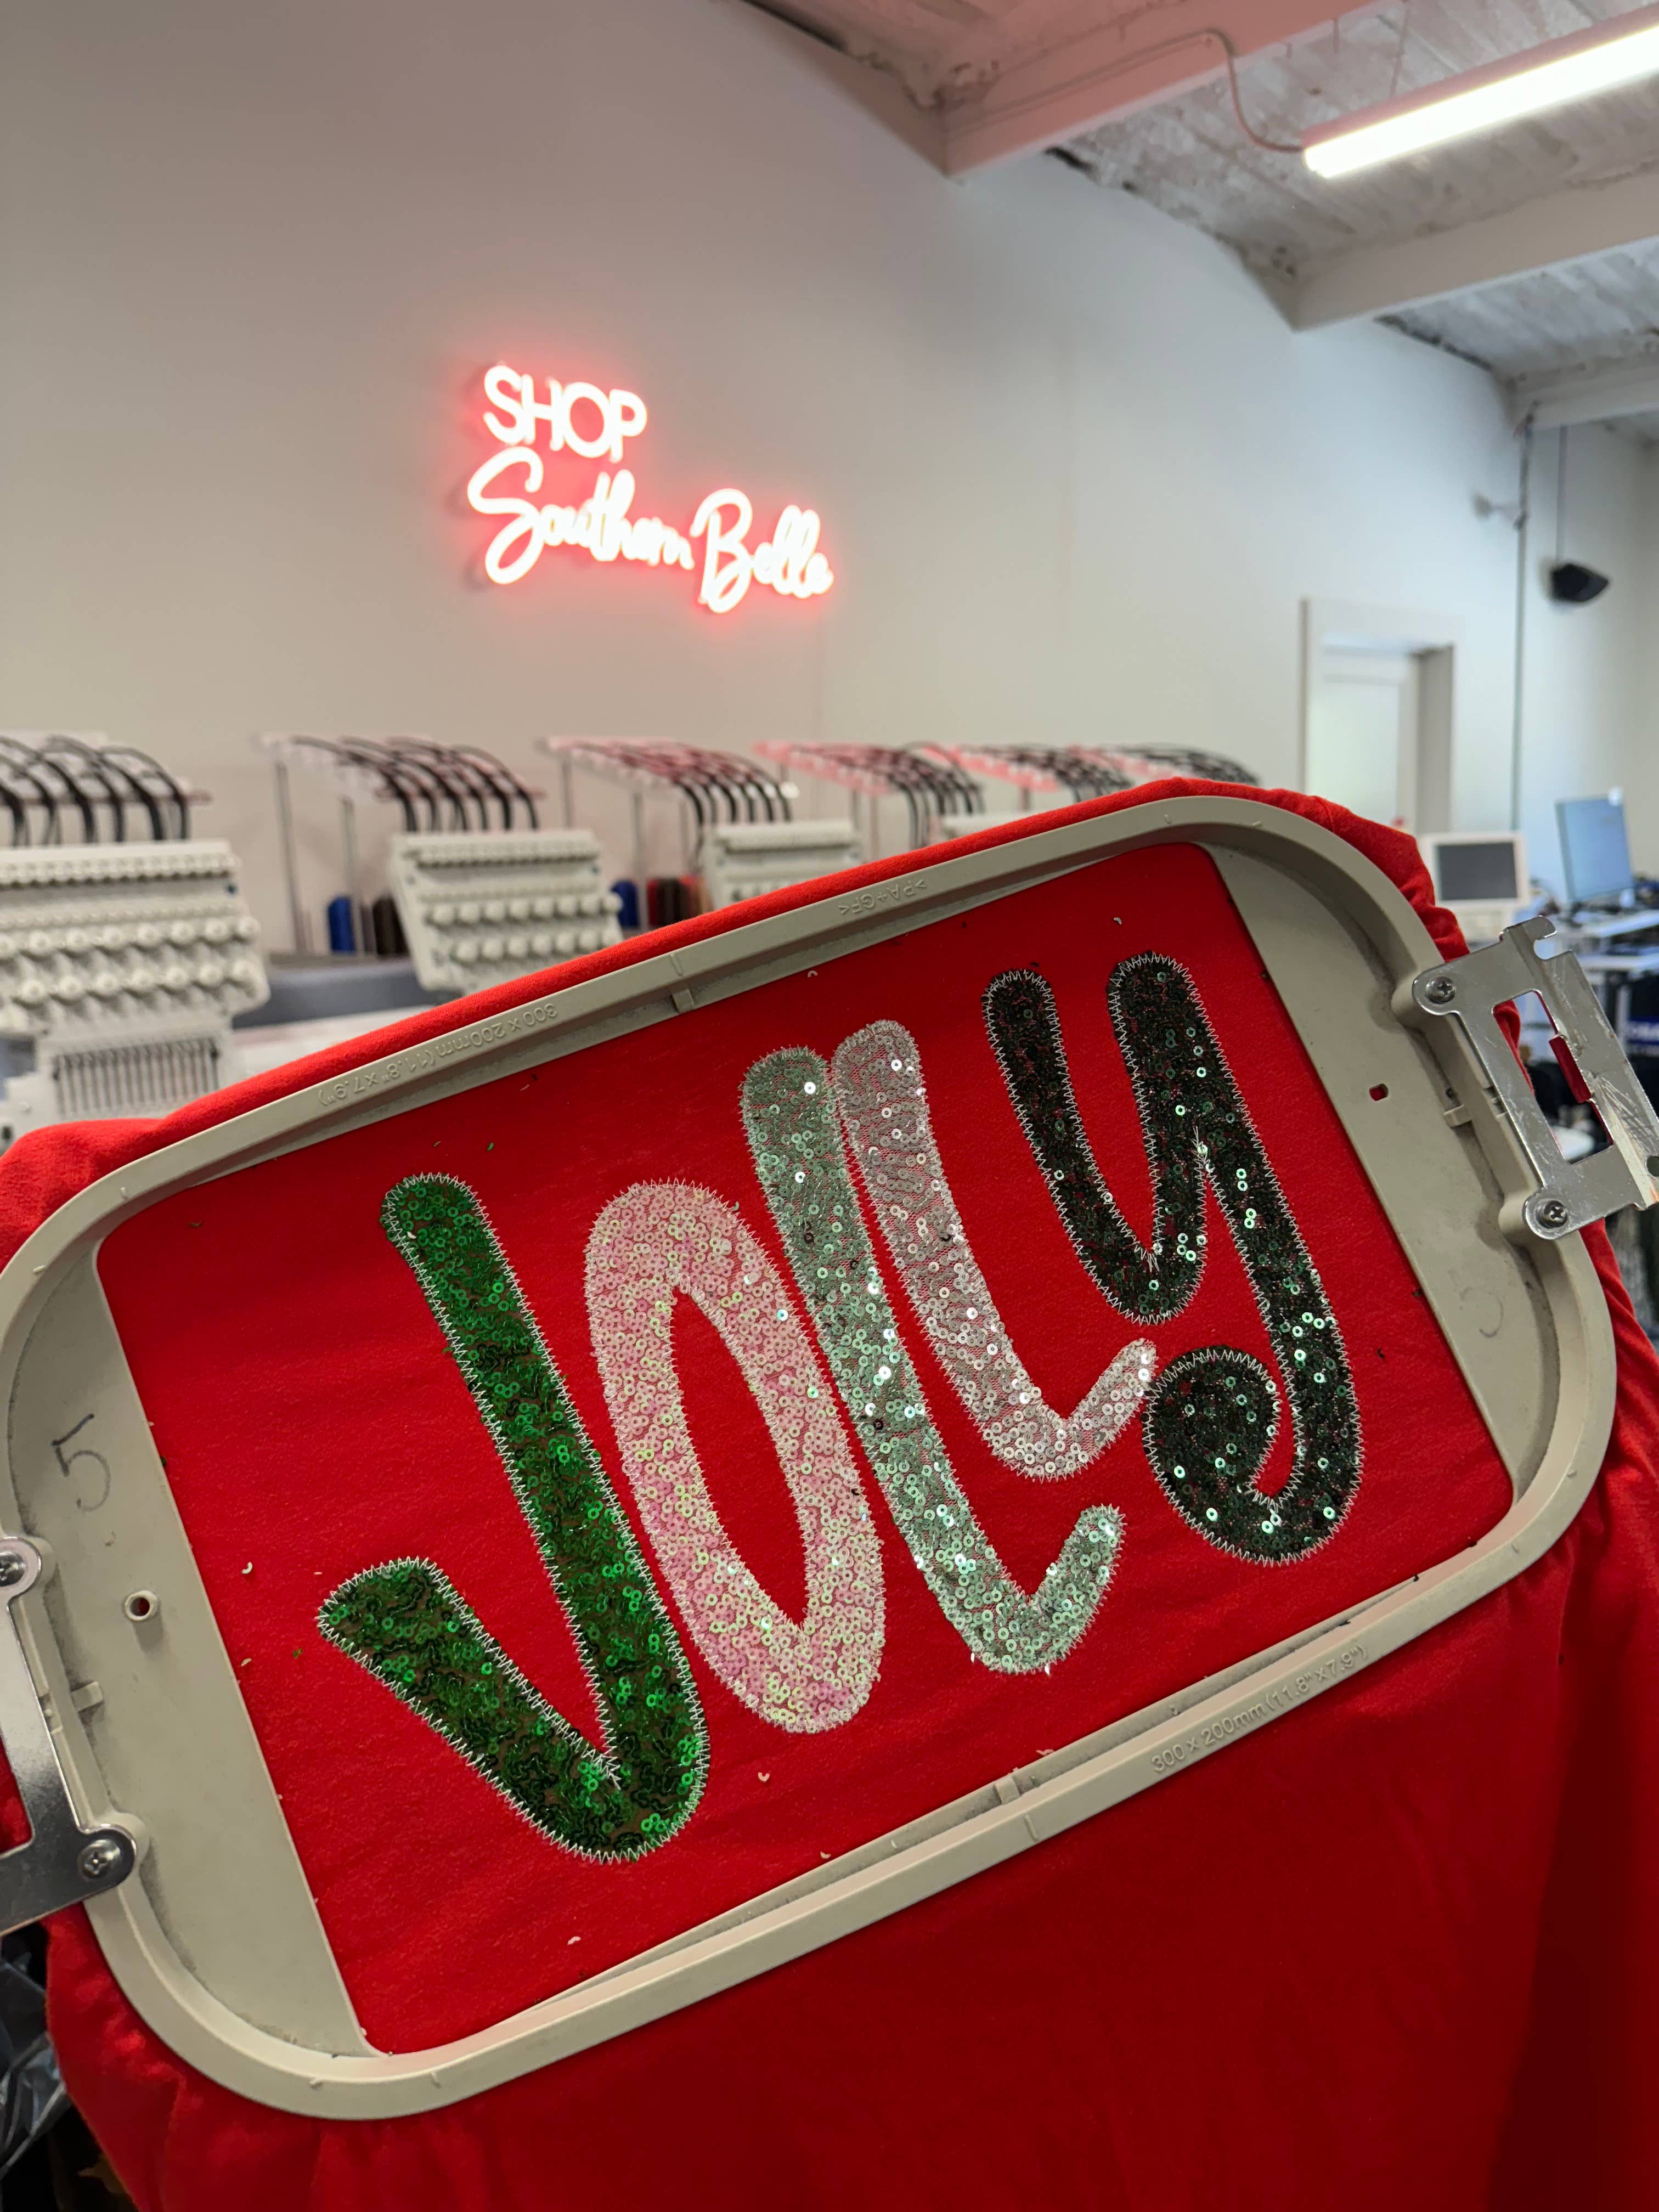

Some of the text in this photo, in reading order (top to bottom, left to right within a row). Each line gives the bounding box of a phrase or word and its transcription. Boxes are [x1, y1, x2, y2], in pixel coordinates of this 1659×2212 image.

[484, 364, 647, 463] SHOP
[467, 445, 834, 614] Southern Belle
[508, 1018, 521, 1031] x
[522, 1003, 558, 1026] 300
[51, 1413, 111, 1512] 5
[1150, 1744, 1186, 1772] 300
[1186, 1737, 1199, 1752] x
